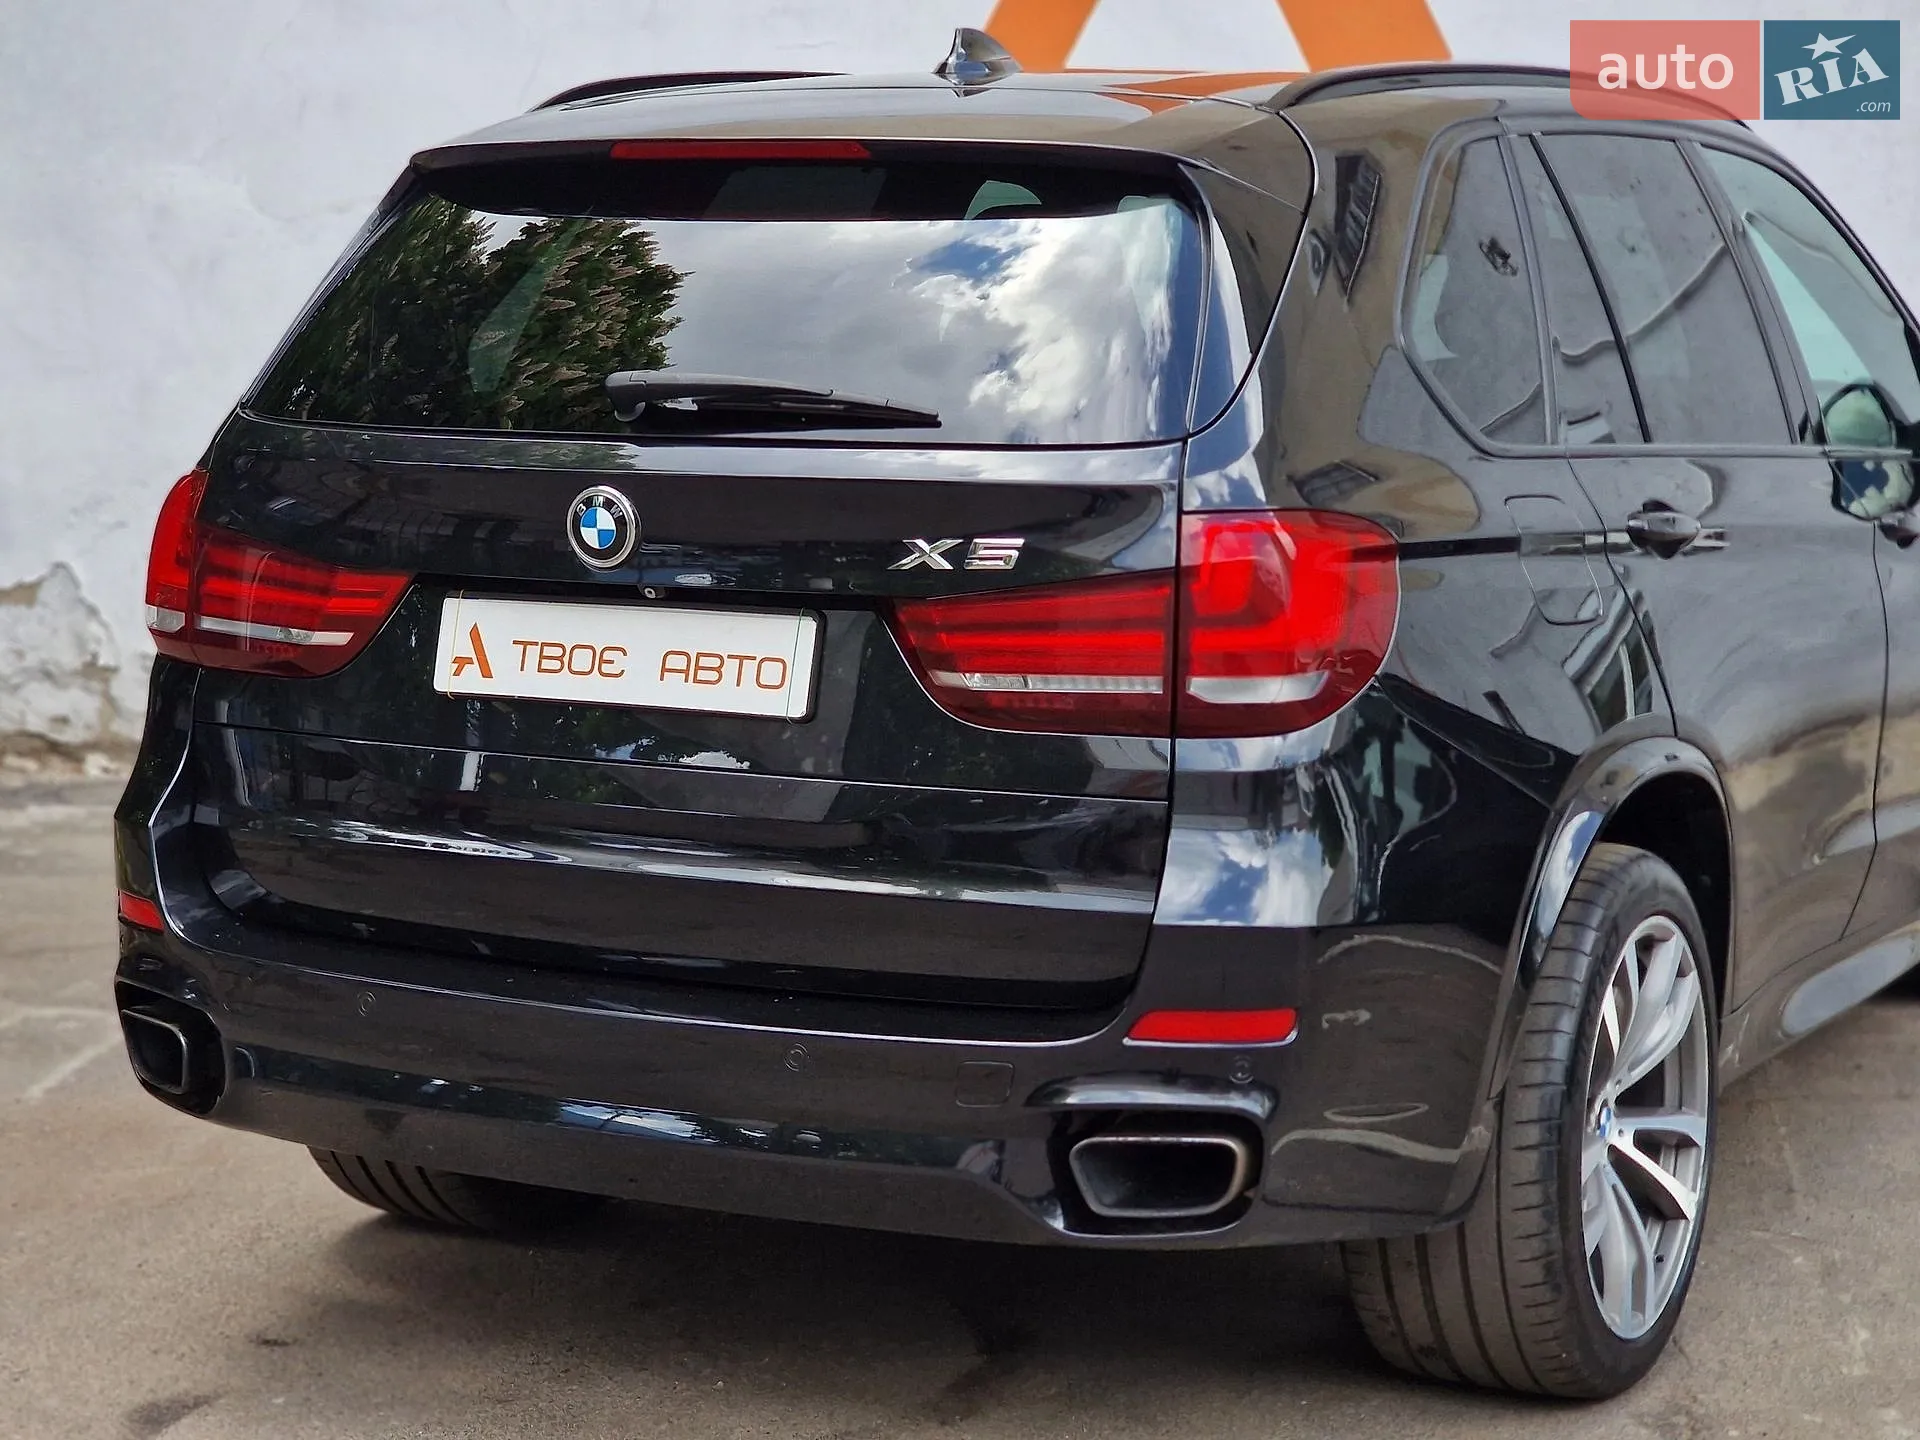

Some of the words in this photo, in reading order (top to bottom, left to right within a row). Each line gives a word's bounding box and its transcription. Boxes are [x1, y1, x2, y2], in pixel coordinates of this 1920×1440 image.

[576, 495, 623, 519] BMW
[886, 538, 1025, 570] X5
[512, 639, 628, 678] ТВОЄ
[659, 650, 788, 690] АВТО
